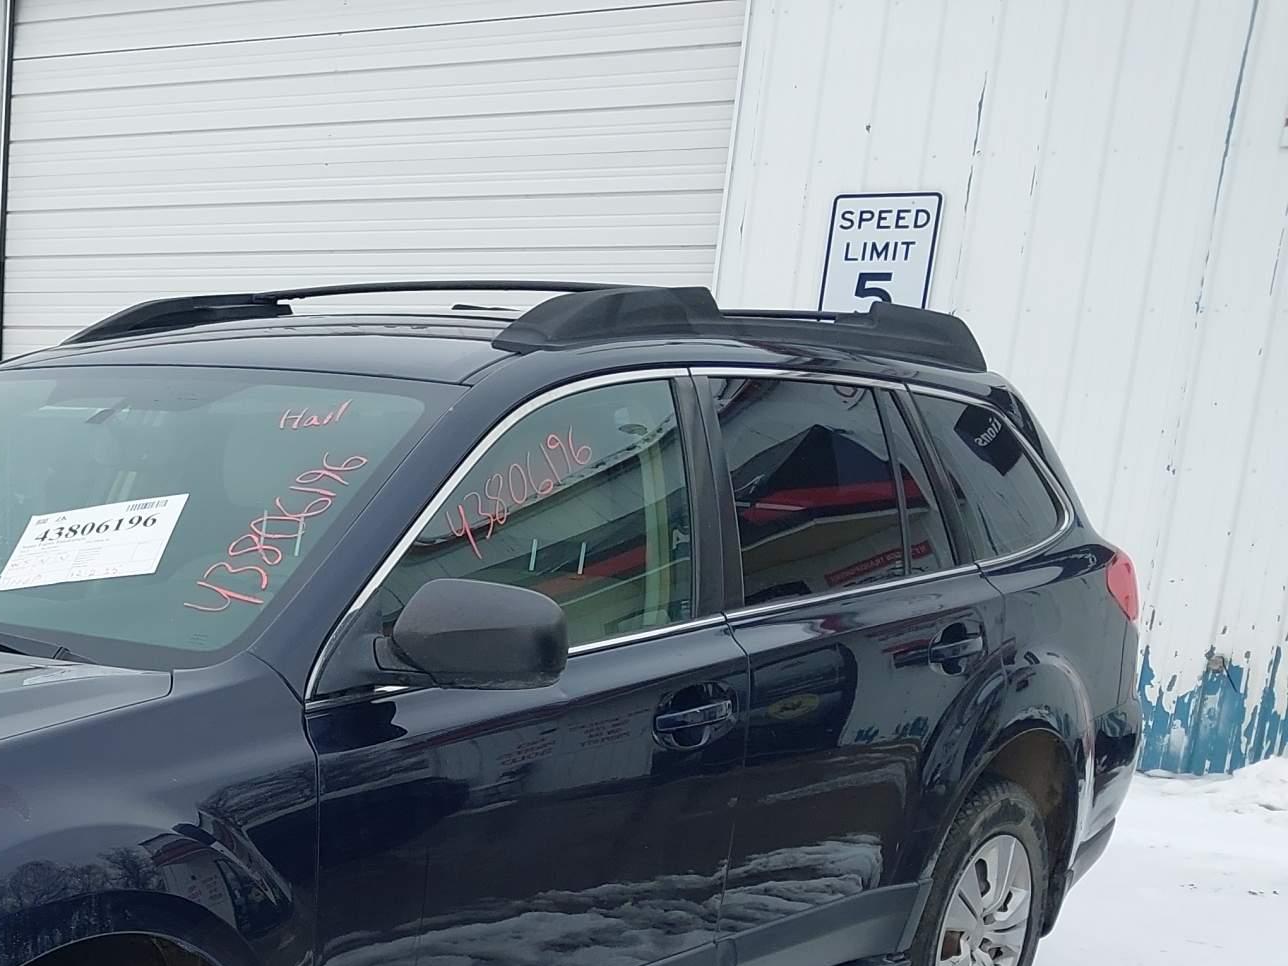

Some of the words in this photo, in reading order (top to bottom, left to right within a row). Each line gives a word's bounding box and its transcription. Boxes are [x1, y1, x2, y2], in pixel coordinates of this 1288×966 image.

[839, 208, 931, 230] SPEED
[843, 240, 916, 262] LIMIT
[854, 272, 893, 304] 5
[279, 398, 353, 431] Hail
[446, 424, 593, 560] 43806196
[34, 512, 161, 543] 43806196
[183, 451, 369, 612] 43806196
